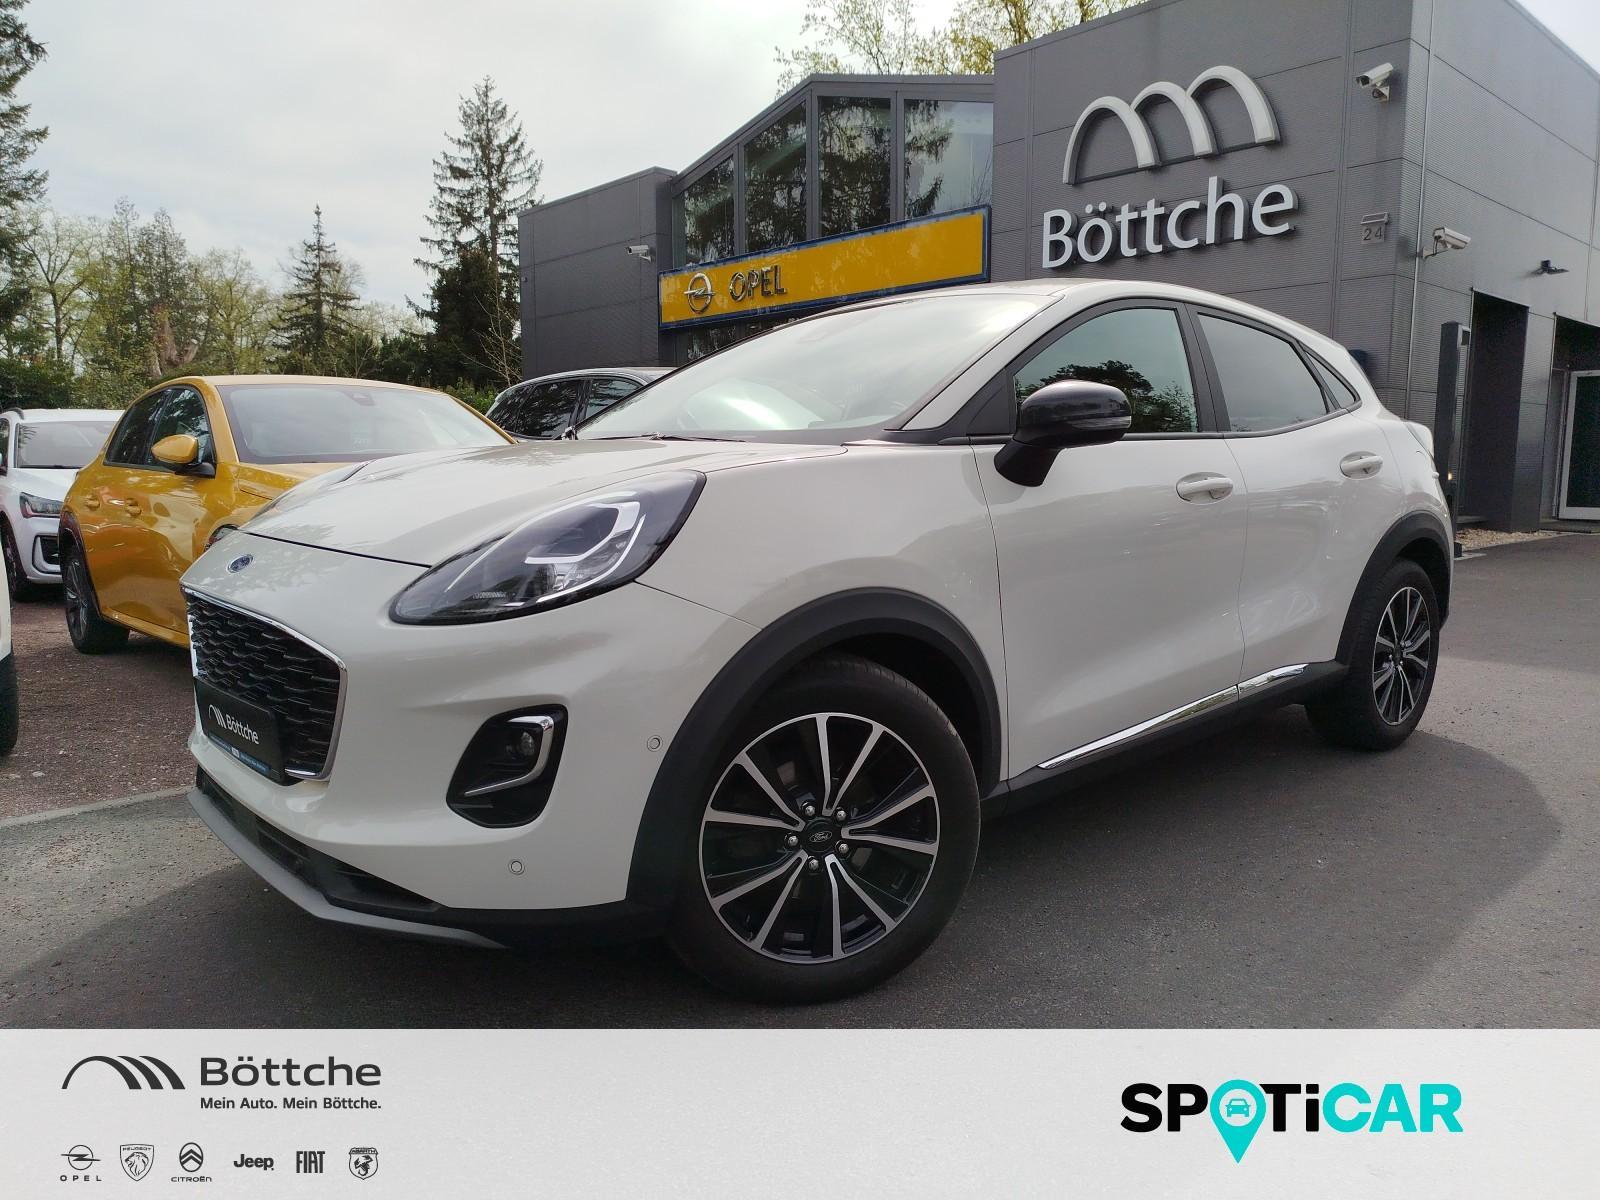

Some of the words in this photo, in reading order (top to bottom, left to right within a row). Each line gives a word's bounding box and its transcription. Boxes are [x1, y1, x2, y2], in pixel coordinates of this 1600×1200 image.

[1041, 175, 1299, 269] Böttche
[1363, 226, 1383, 241] 24
[728, 264, 787, 302] OPEL
[226, 713, 259, 745] Böttche
